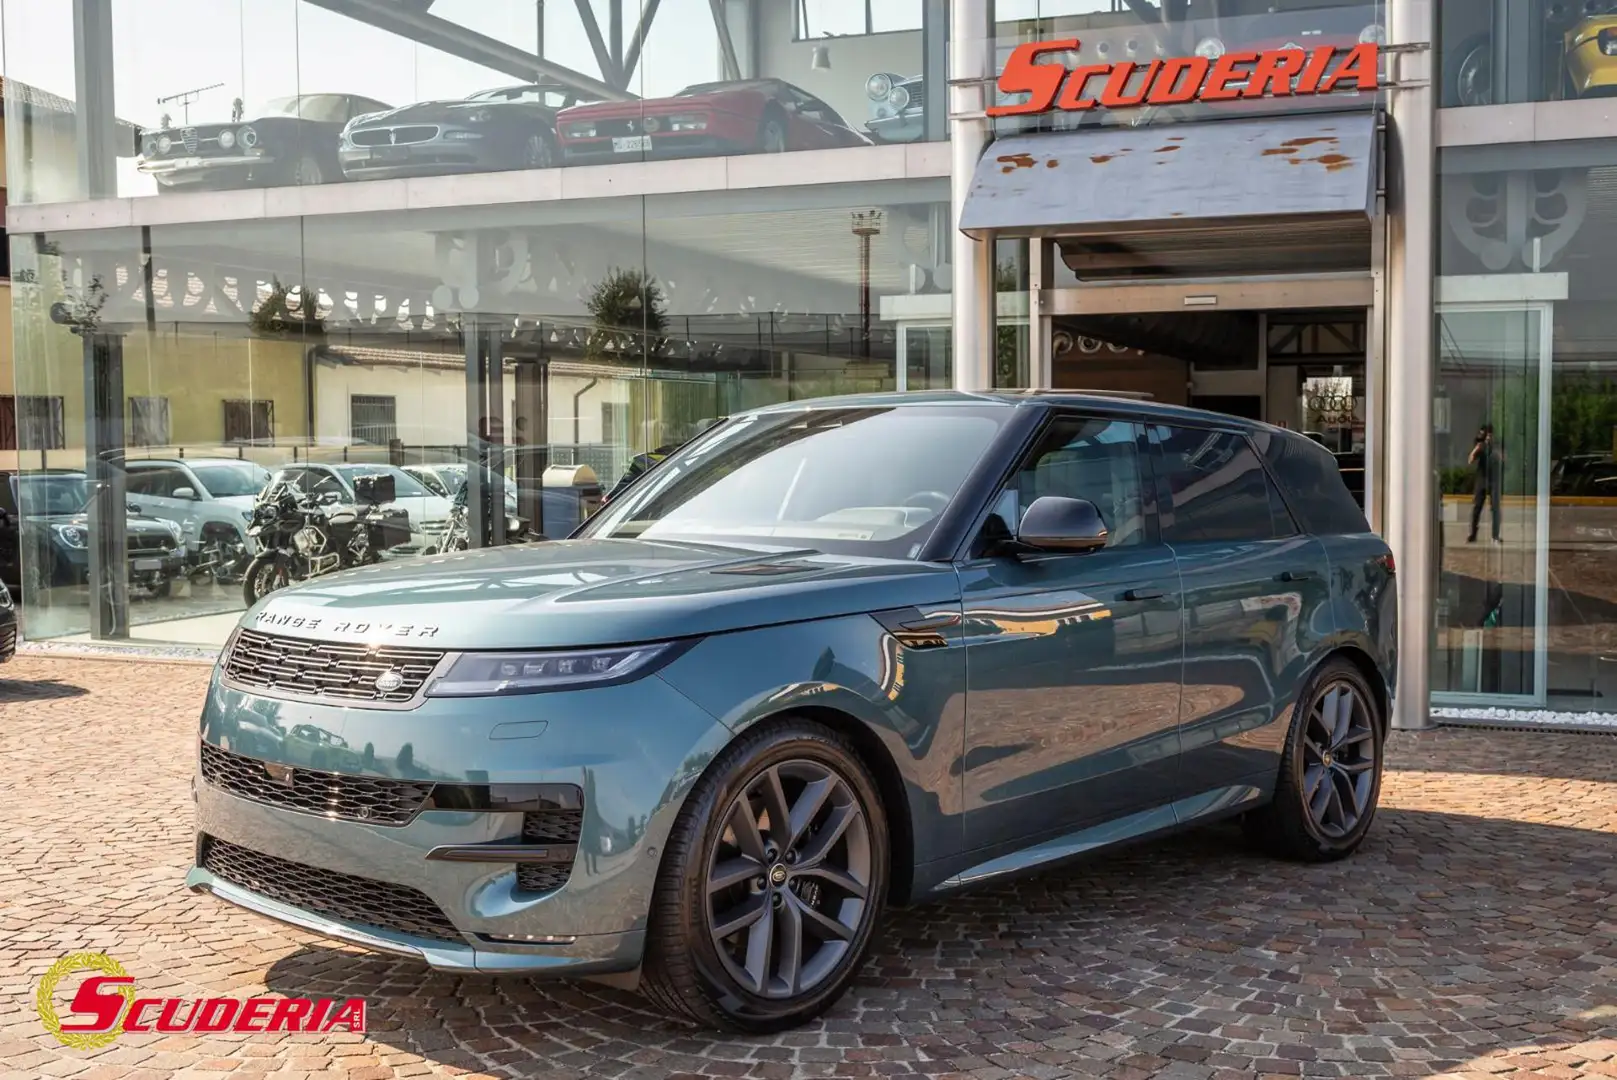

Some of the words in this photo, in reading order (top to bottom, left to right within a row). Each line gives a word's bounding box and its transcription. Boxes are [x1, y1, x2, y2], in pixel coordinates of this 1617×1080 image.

[987, 39, 1378, 117] SCUDERIA
[255, 611, 322, 629] RANGE
[333, 621, 439, 637] ROVER
